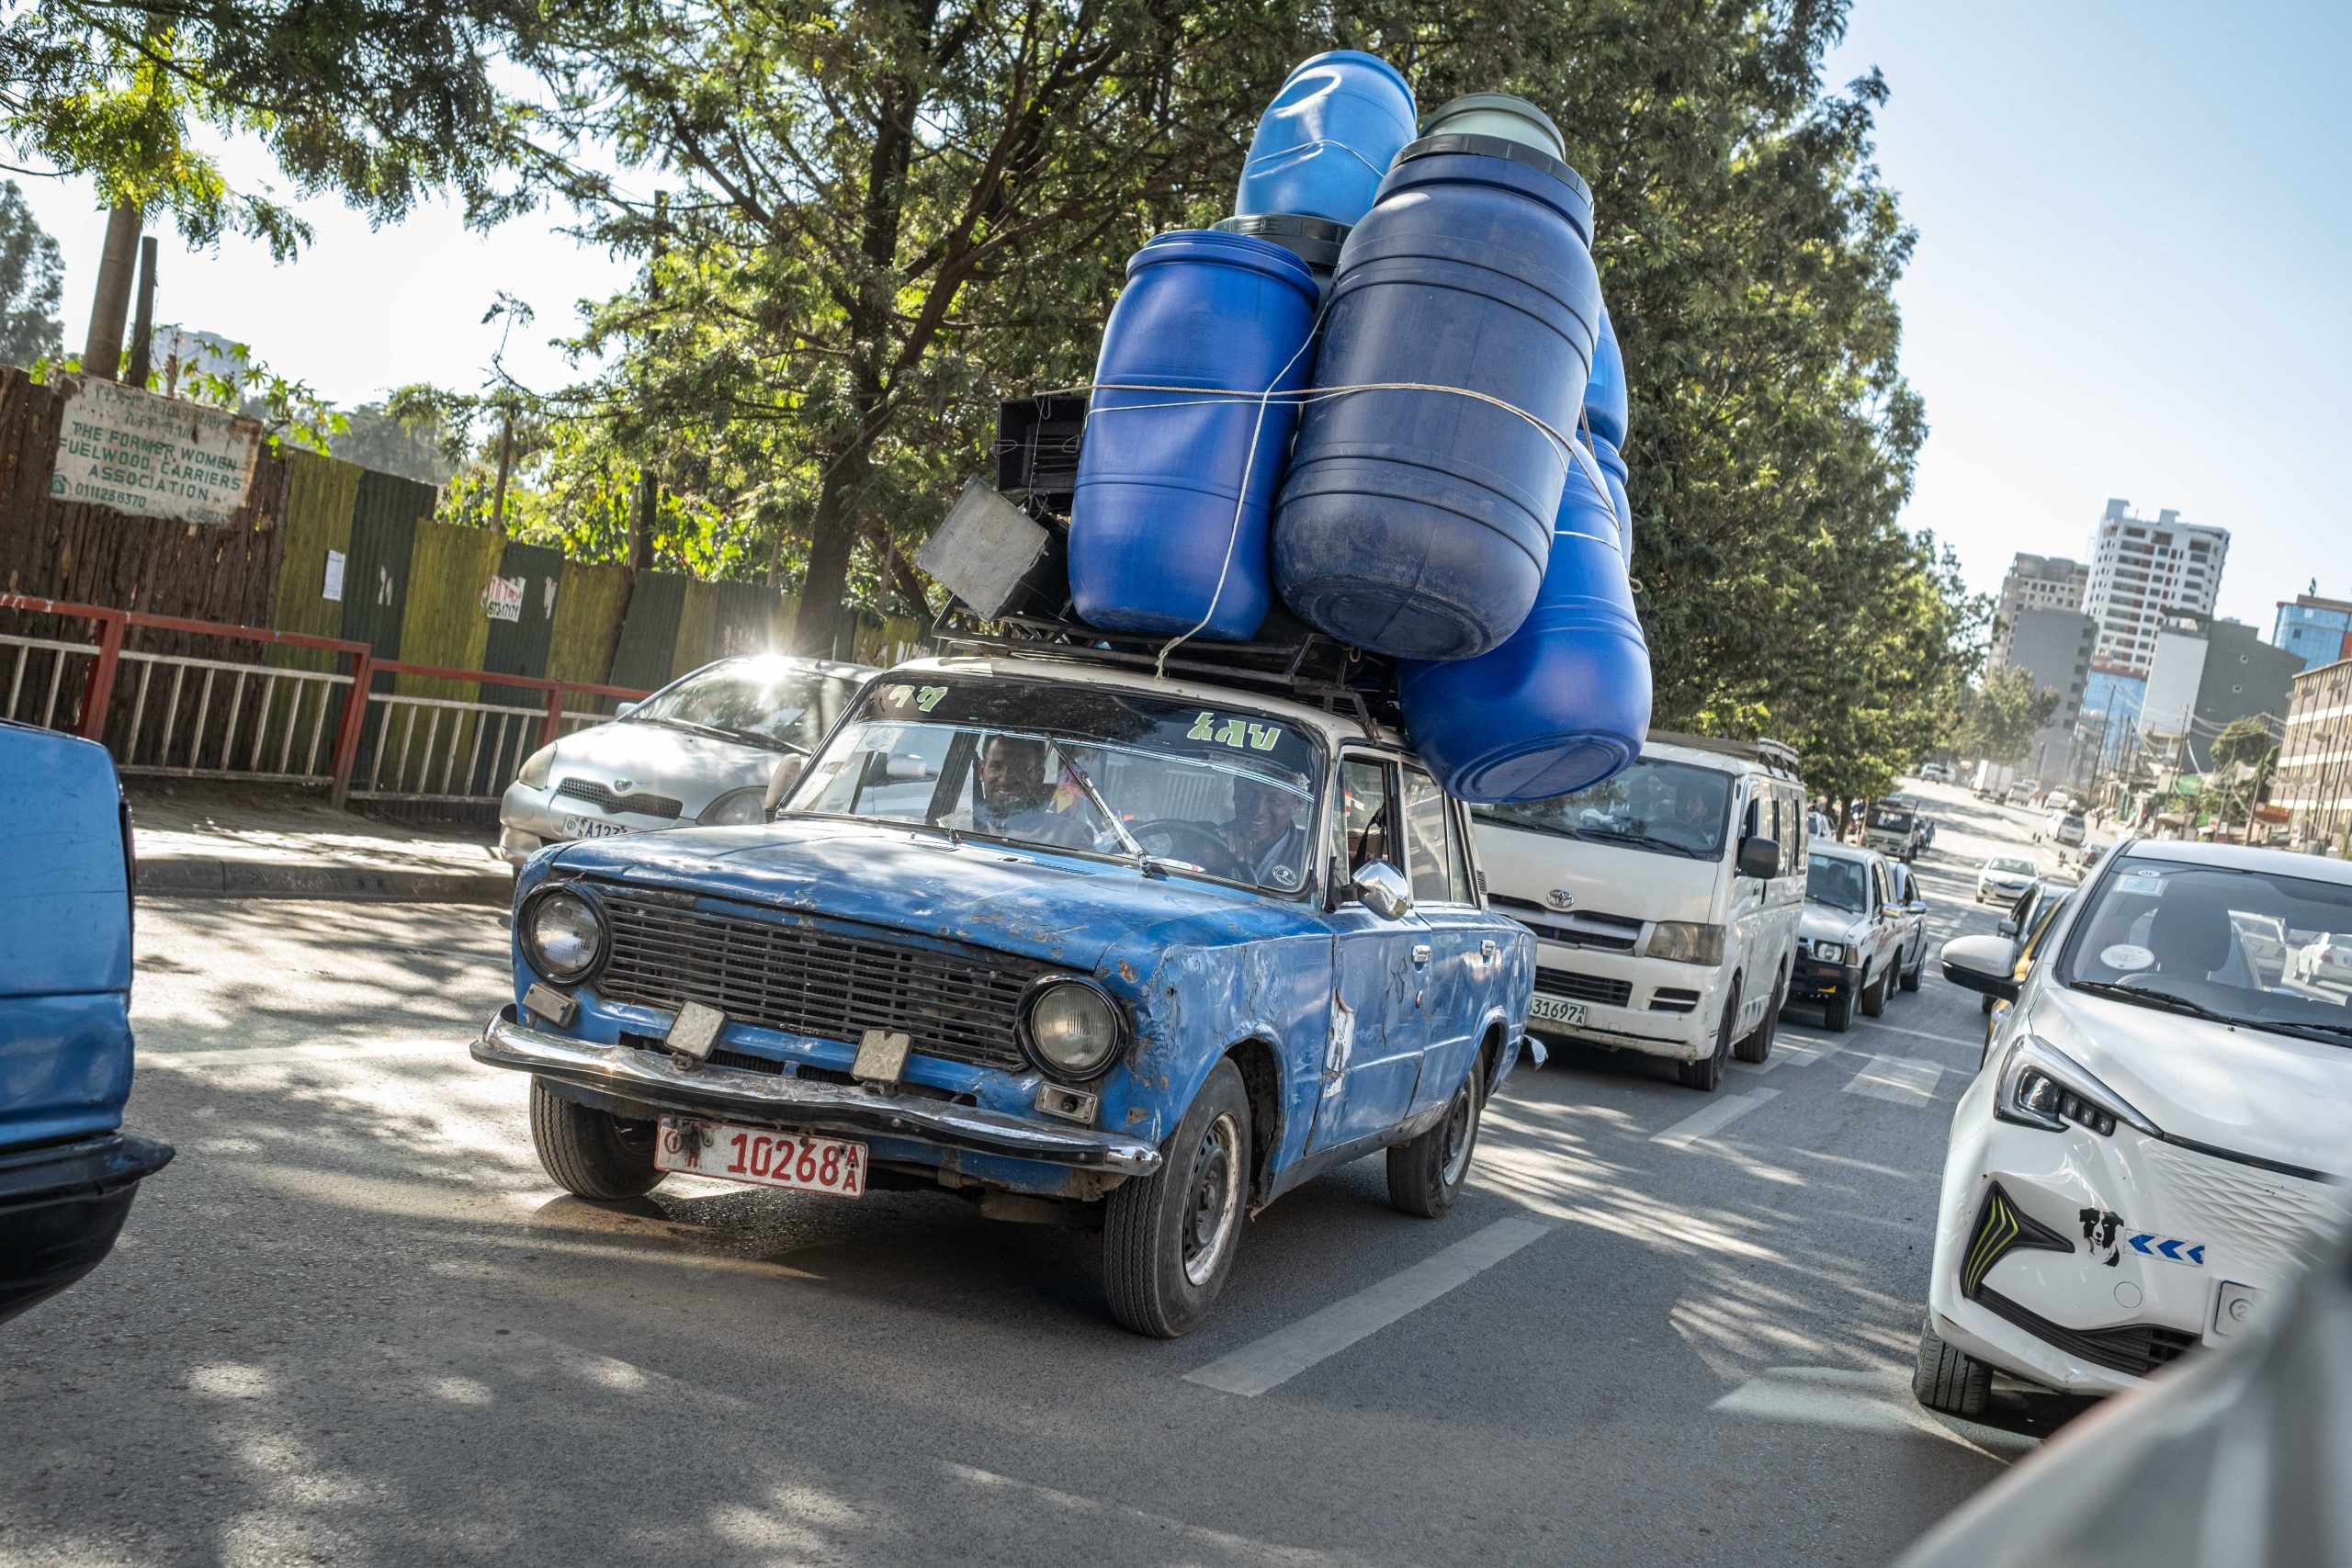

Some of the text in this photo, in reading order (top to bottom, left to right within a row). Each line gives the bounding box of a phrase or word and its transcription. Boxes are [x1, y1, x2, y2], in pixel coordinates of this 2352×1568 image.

[59, 437, 243, 491] FUELWOOD CARRIERS
[72, 421, 237, 472] THE FORMER WOMEN
[88, 464, 209, 502] ASSOCIATION
[1529, 998, 1577, 1021] 31697
[727, 1133, 840, 1186] 10268
